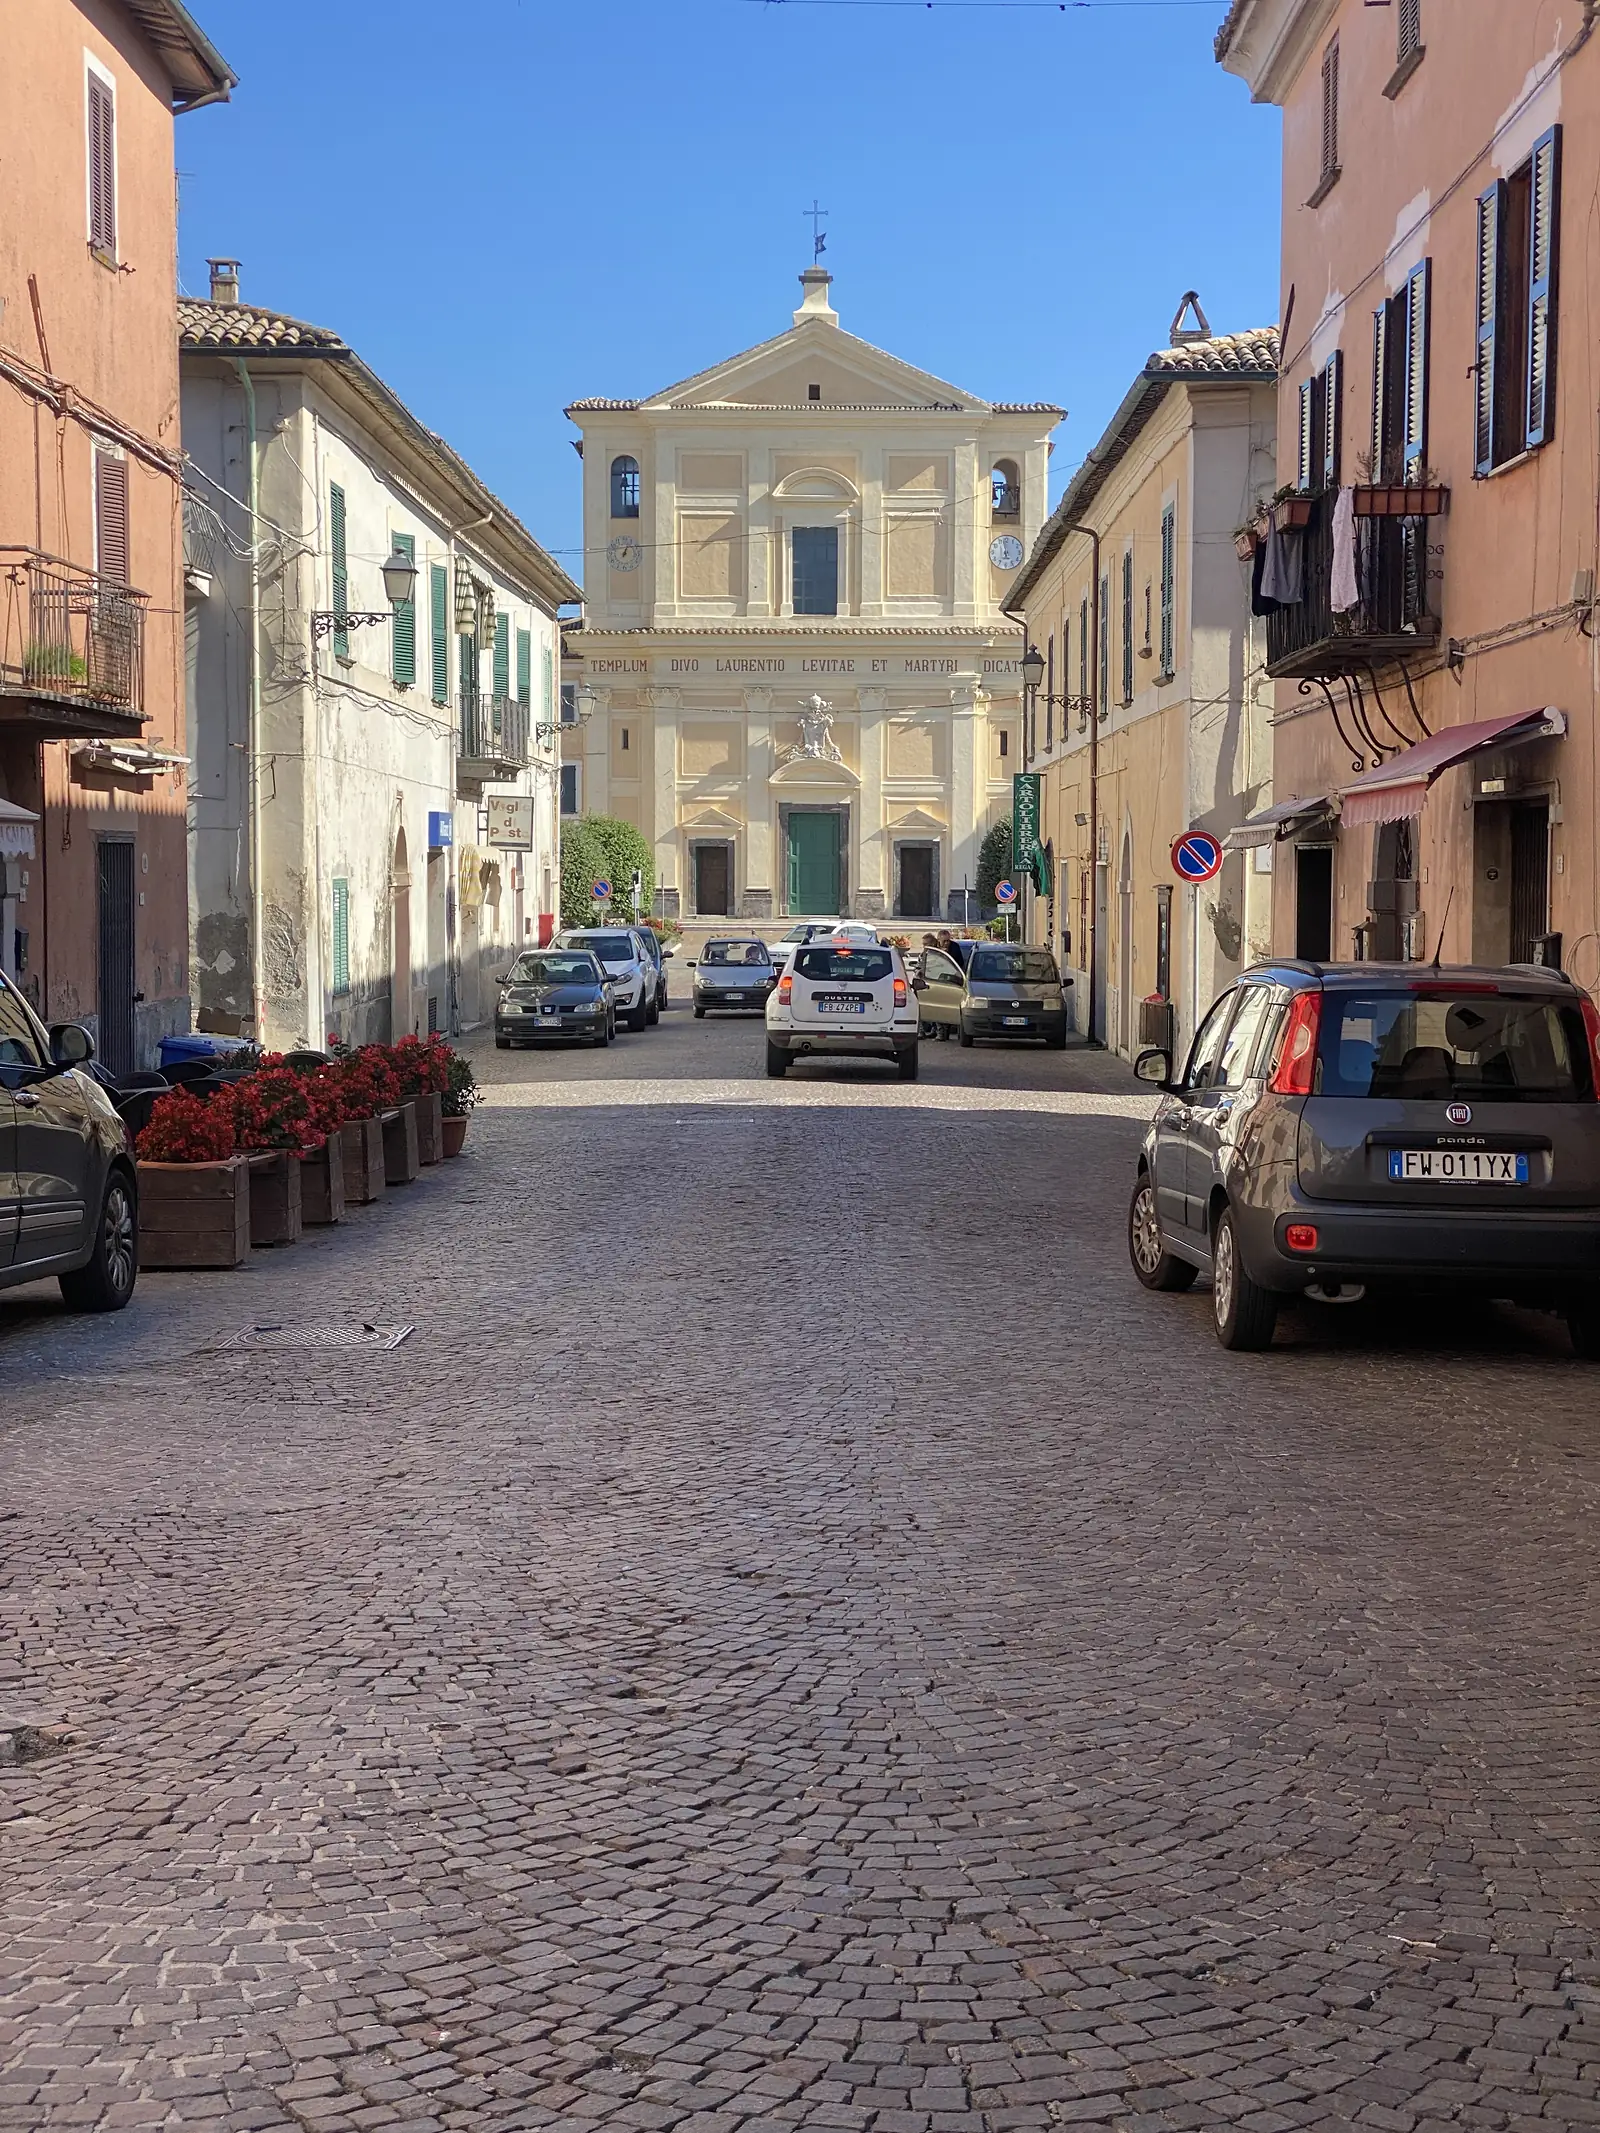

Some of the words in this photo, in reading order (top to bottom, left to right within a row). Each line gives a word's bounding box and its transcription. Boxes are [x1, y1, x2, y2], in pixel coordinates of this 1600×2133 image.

[591, 659, 648, 672] TEMPLUM
[671, 659, 699, 672] DIVO
[716, 659, 785, 672] LAURENTIO
[802, 659, 855, 672] LEVITAE
[871, 659, 888, 672] ET
[904, 659, 958, 672] MARTYRI
[983, 659, 1023, 673] DICAT
[1019, 775, 1035, 864] CARTOLIBRERIA
[1452, 1108, 1466, 1119] FIAT
[1437, 1136, 1485, 1144] panda
[1405, 1153, 1432, 1176] FW
[1442, 1154, 1512, 1178] 011YX
